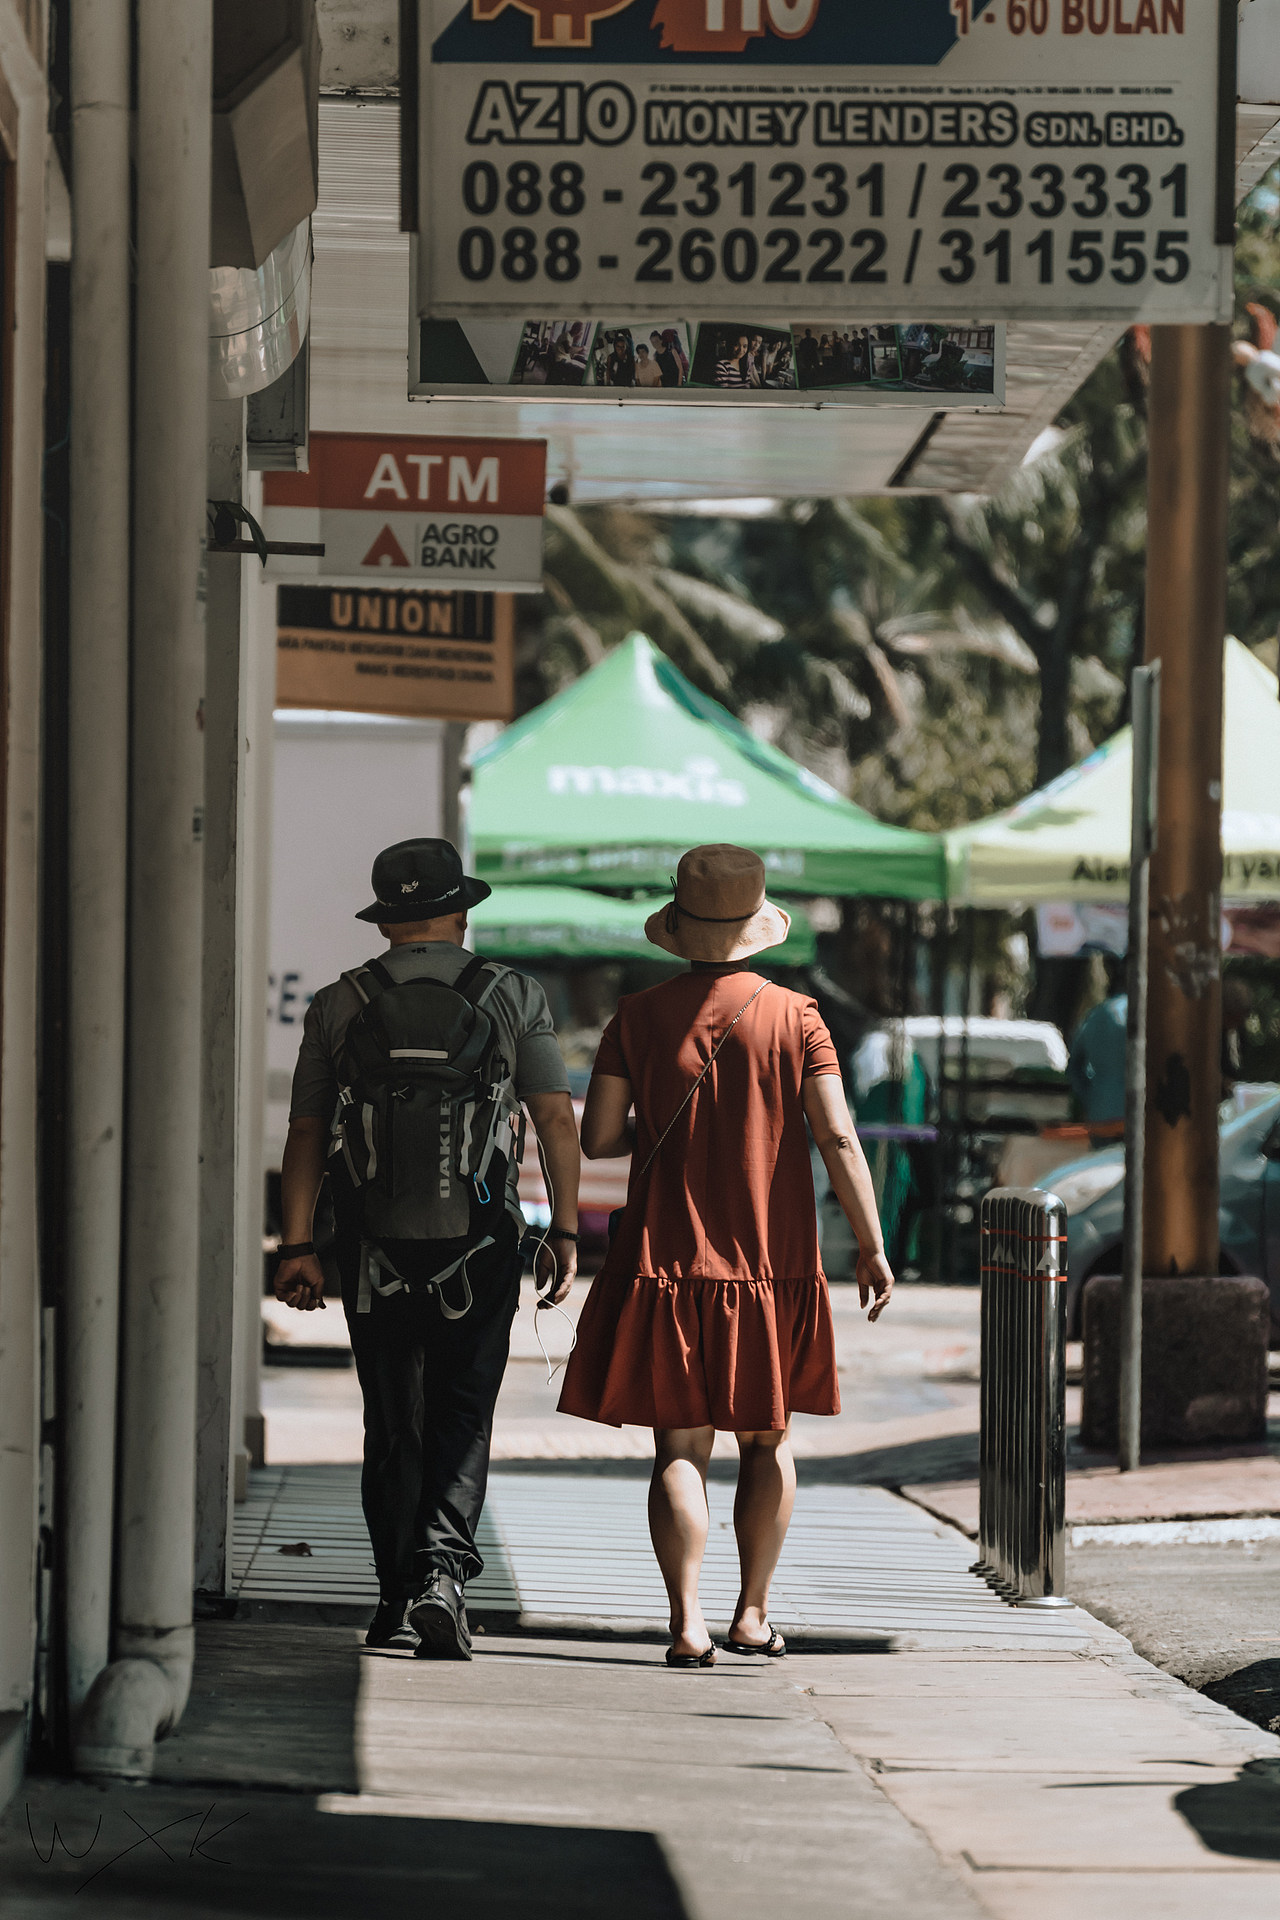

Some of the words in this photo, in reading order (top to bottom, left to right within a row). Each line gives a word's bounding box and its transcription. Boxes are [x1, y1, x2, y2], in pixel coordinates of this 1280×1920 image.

[1007, 0, 1048, 35] 60
[1061, 0, 1184, 34] BULAN
[467, 81, 635, 144] AZIO
[644, 101, 807, 146] MONEY
[814, 101, 1017, 146] LENDERS
[1025, 111, 1101, 146] SDN.
[1106, 111, 1184, 146] BHD.
[462, 160, 586, 216] 088
[639, 161, 884, 218] 231231
[942, 163, 1187, 218] 233331
[458, 226, 581, 282] 088
[635, 227, 887, 284] 260222
[938, 229, 1190, 284] 311555
[363, 453, 500, 503] ATM
[421, 523, 499, 546] AGRO
[421, 547, 496, 570] BANK
[331, 592, 453, 634] UNION
[547, 756, 748, 807] maxis
[440, 1090, 451, 1198] OAKLEY
